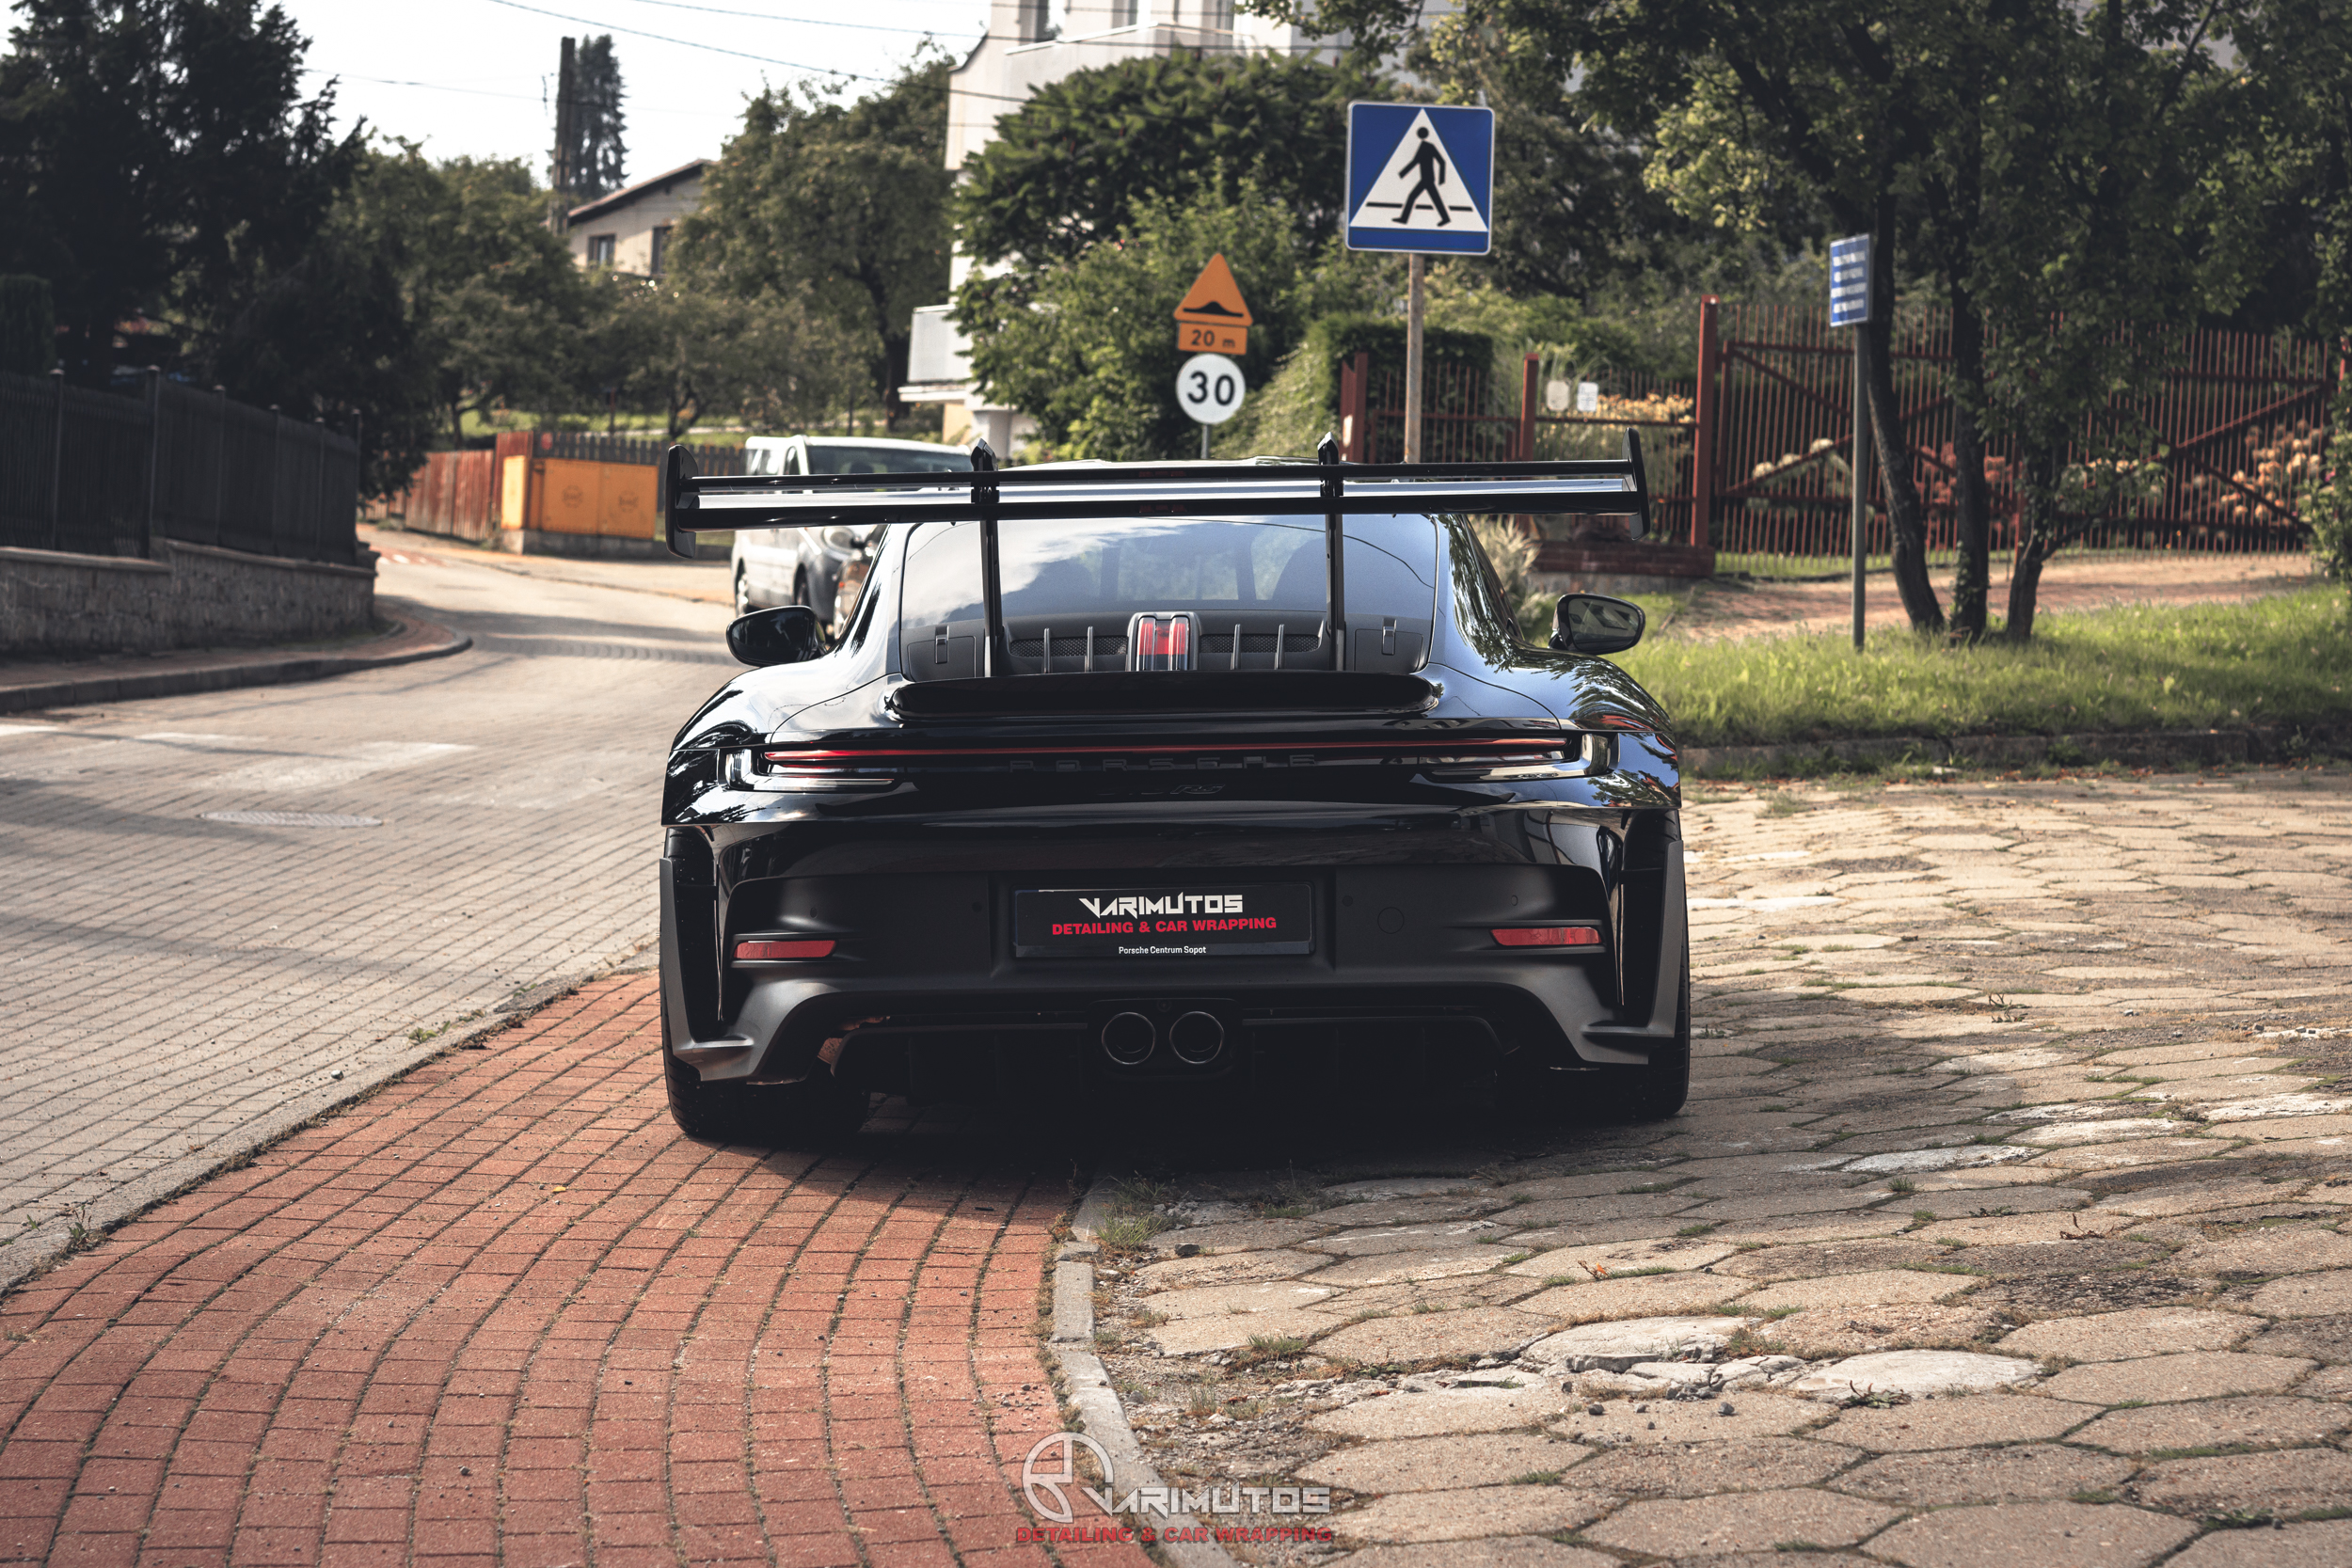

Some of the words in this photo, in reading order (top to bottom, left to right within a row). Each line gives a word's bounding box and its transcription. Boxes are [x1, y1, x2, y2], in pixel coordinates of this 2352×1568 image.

[1190, 329, 1215, 346] 20
[1222, 338, 1235, 348] m
[1187, 371, 1235, 406] 30
[1009, 754, 1316, 772] PORSCHE
[1078, 892, 1243, 919] VARIMUTOS
[1052, 922, 1134, 935] DETAILING
[1138, 921, 1151, 933] &
[1155, 920, 1187, 932] CAR
[1192, 917, 1277, 931] WRAPPING
[1119, 946, 1149, 955] Porsche
[1150, 946, 1183, 955] Centrum
[1184, 946, 1206, 956] Sopot
